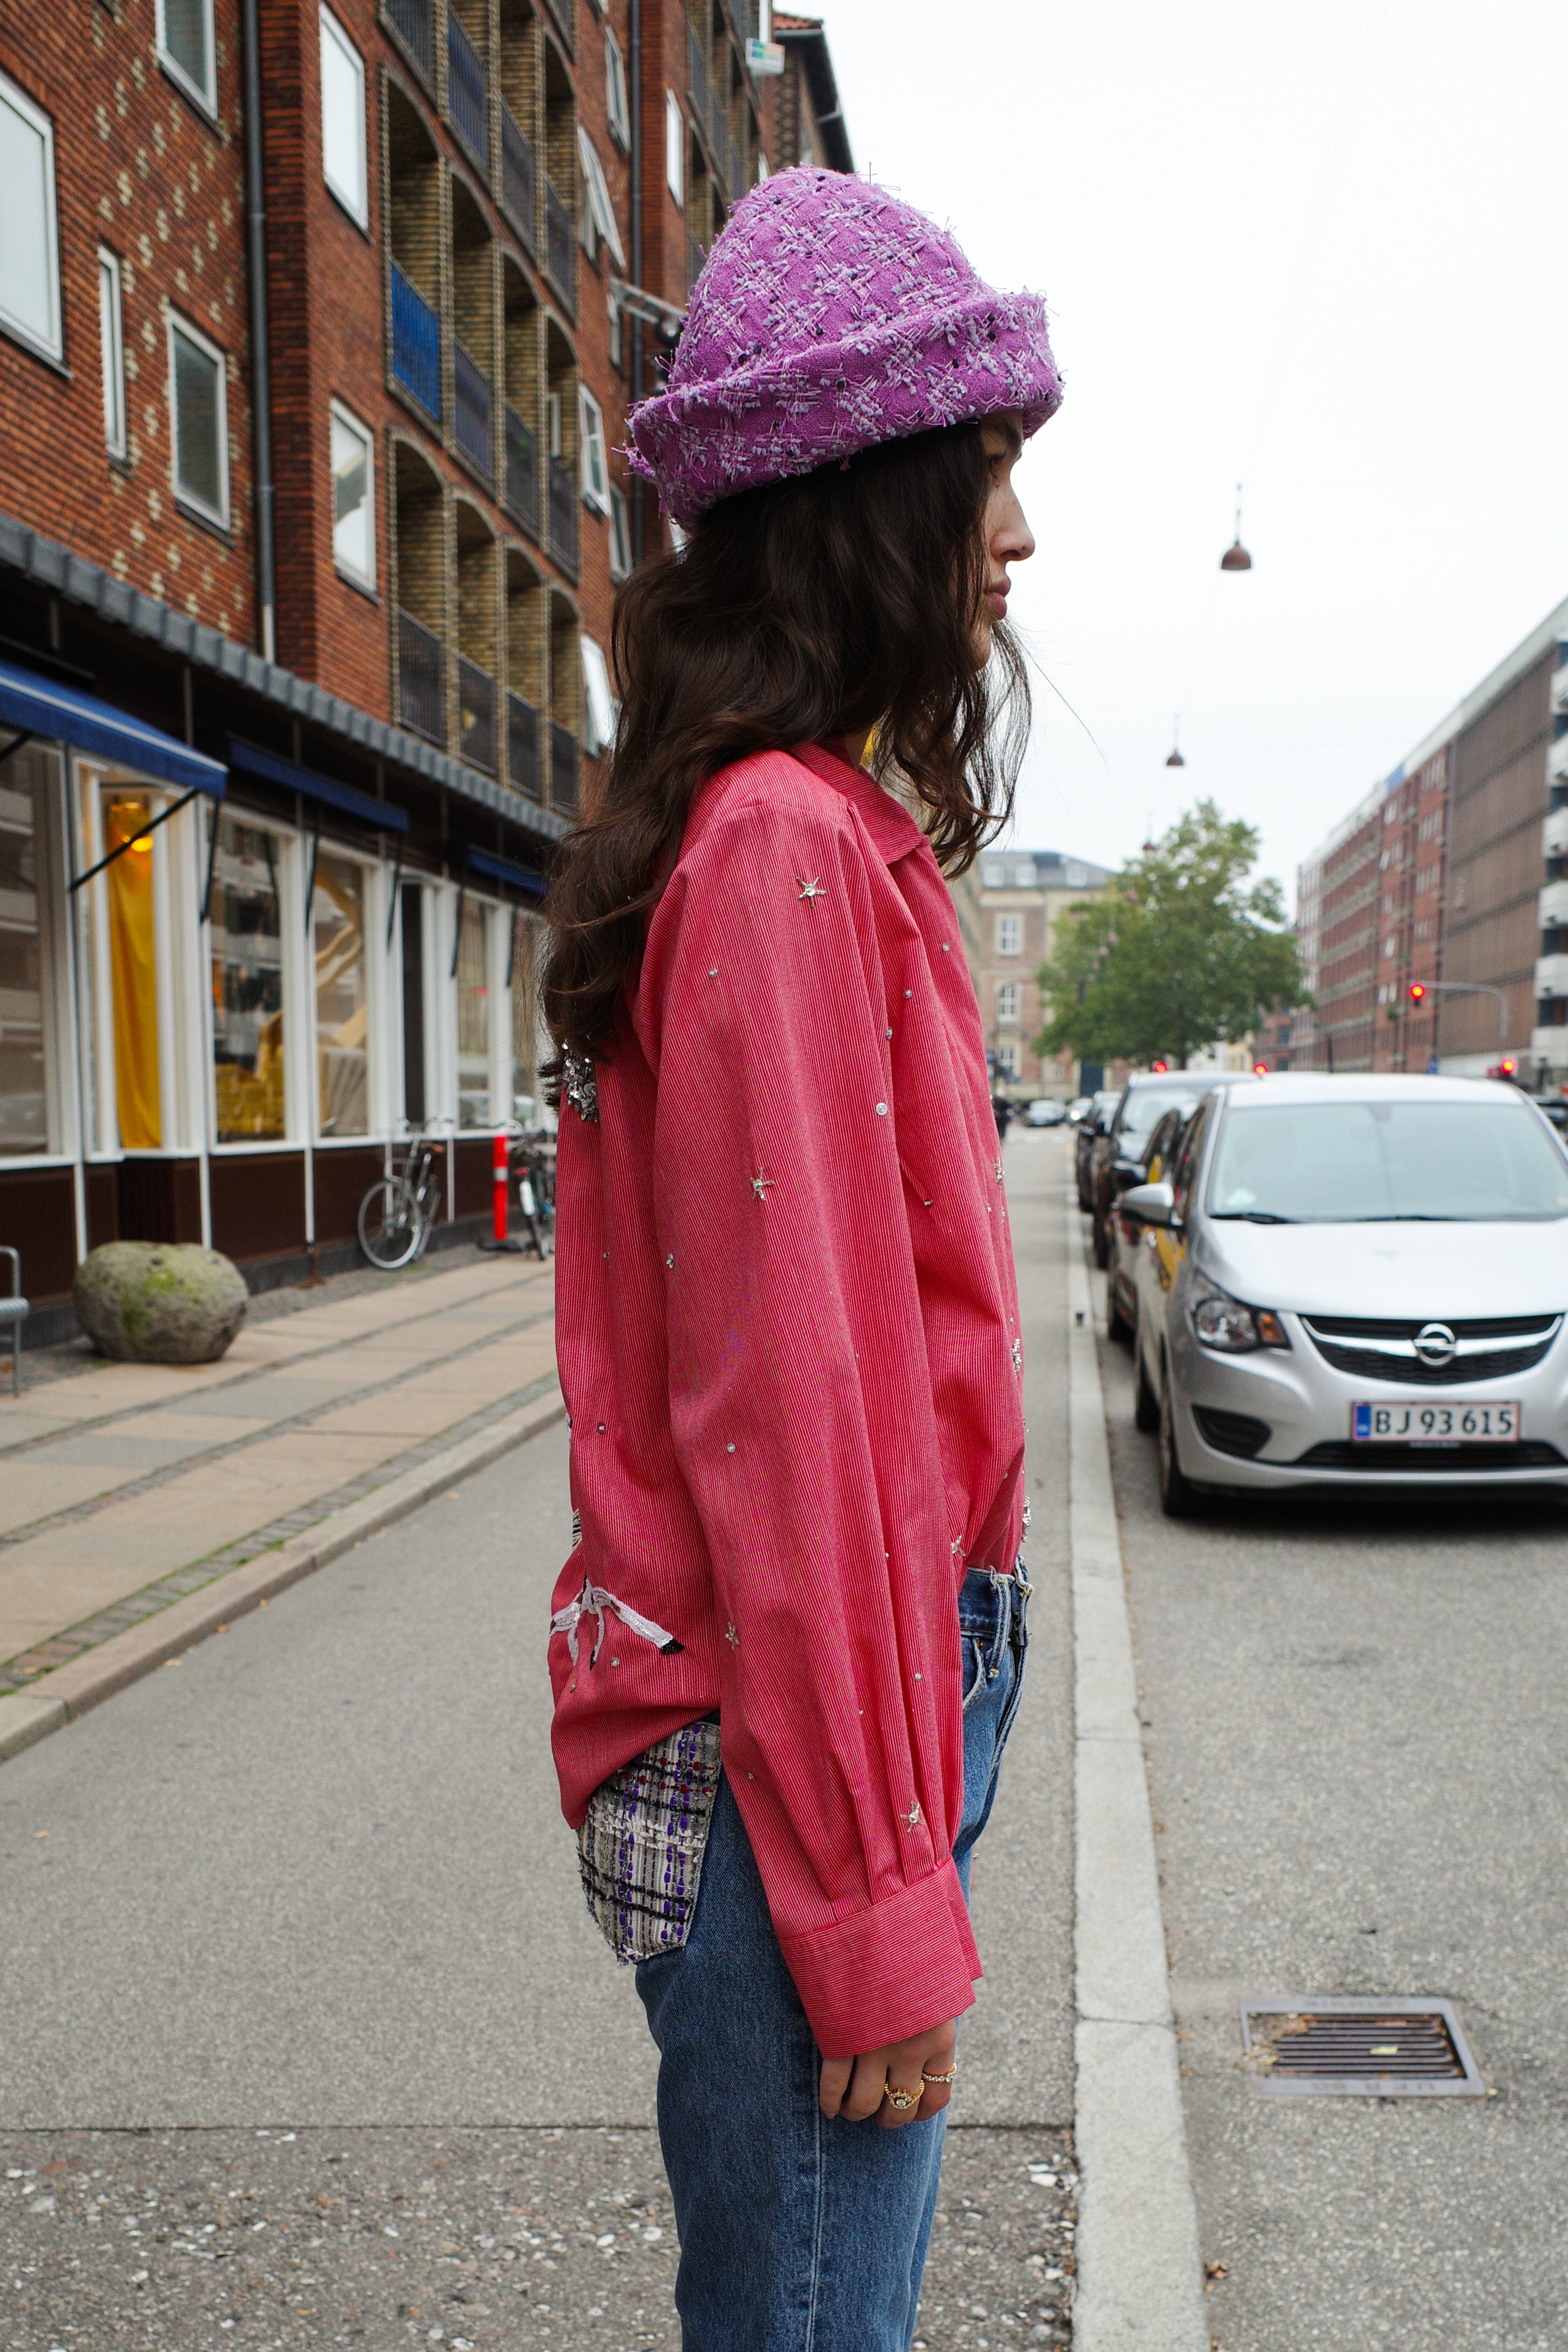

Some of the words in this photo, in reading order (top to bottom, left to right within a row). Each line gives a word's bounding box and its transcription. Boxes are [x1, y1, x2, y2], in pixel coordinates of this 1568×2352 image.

[1376, 1409, 1410, 1434] BJ
[1421, 1409, 1452, 1434] 93
[1462, 1409, 1512, 1434] 615
